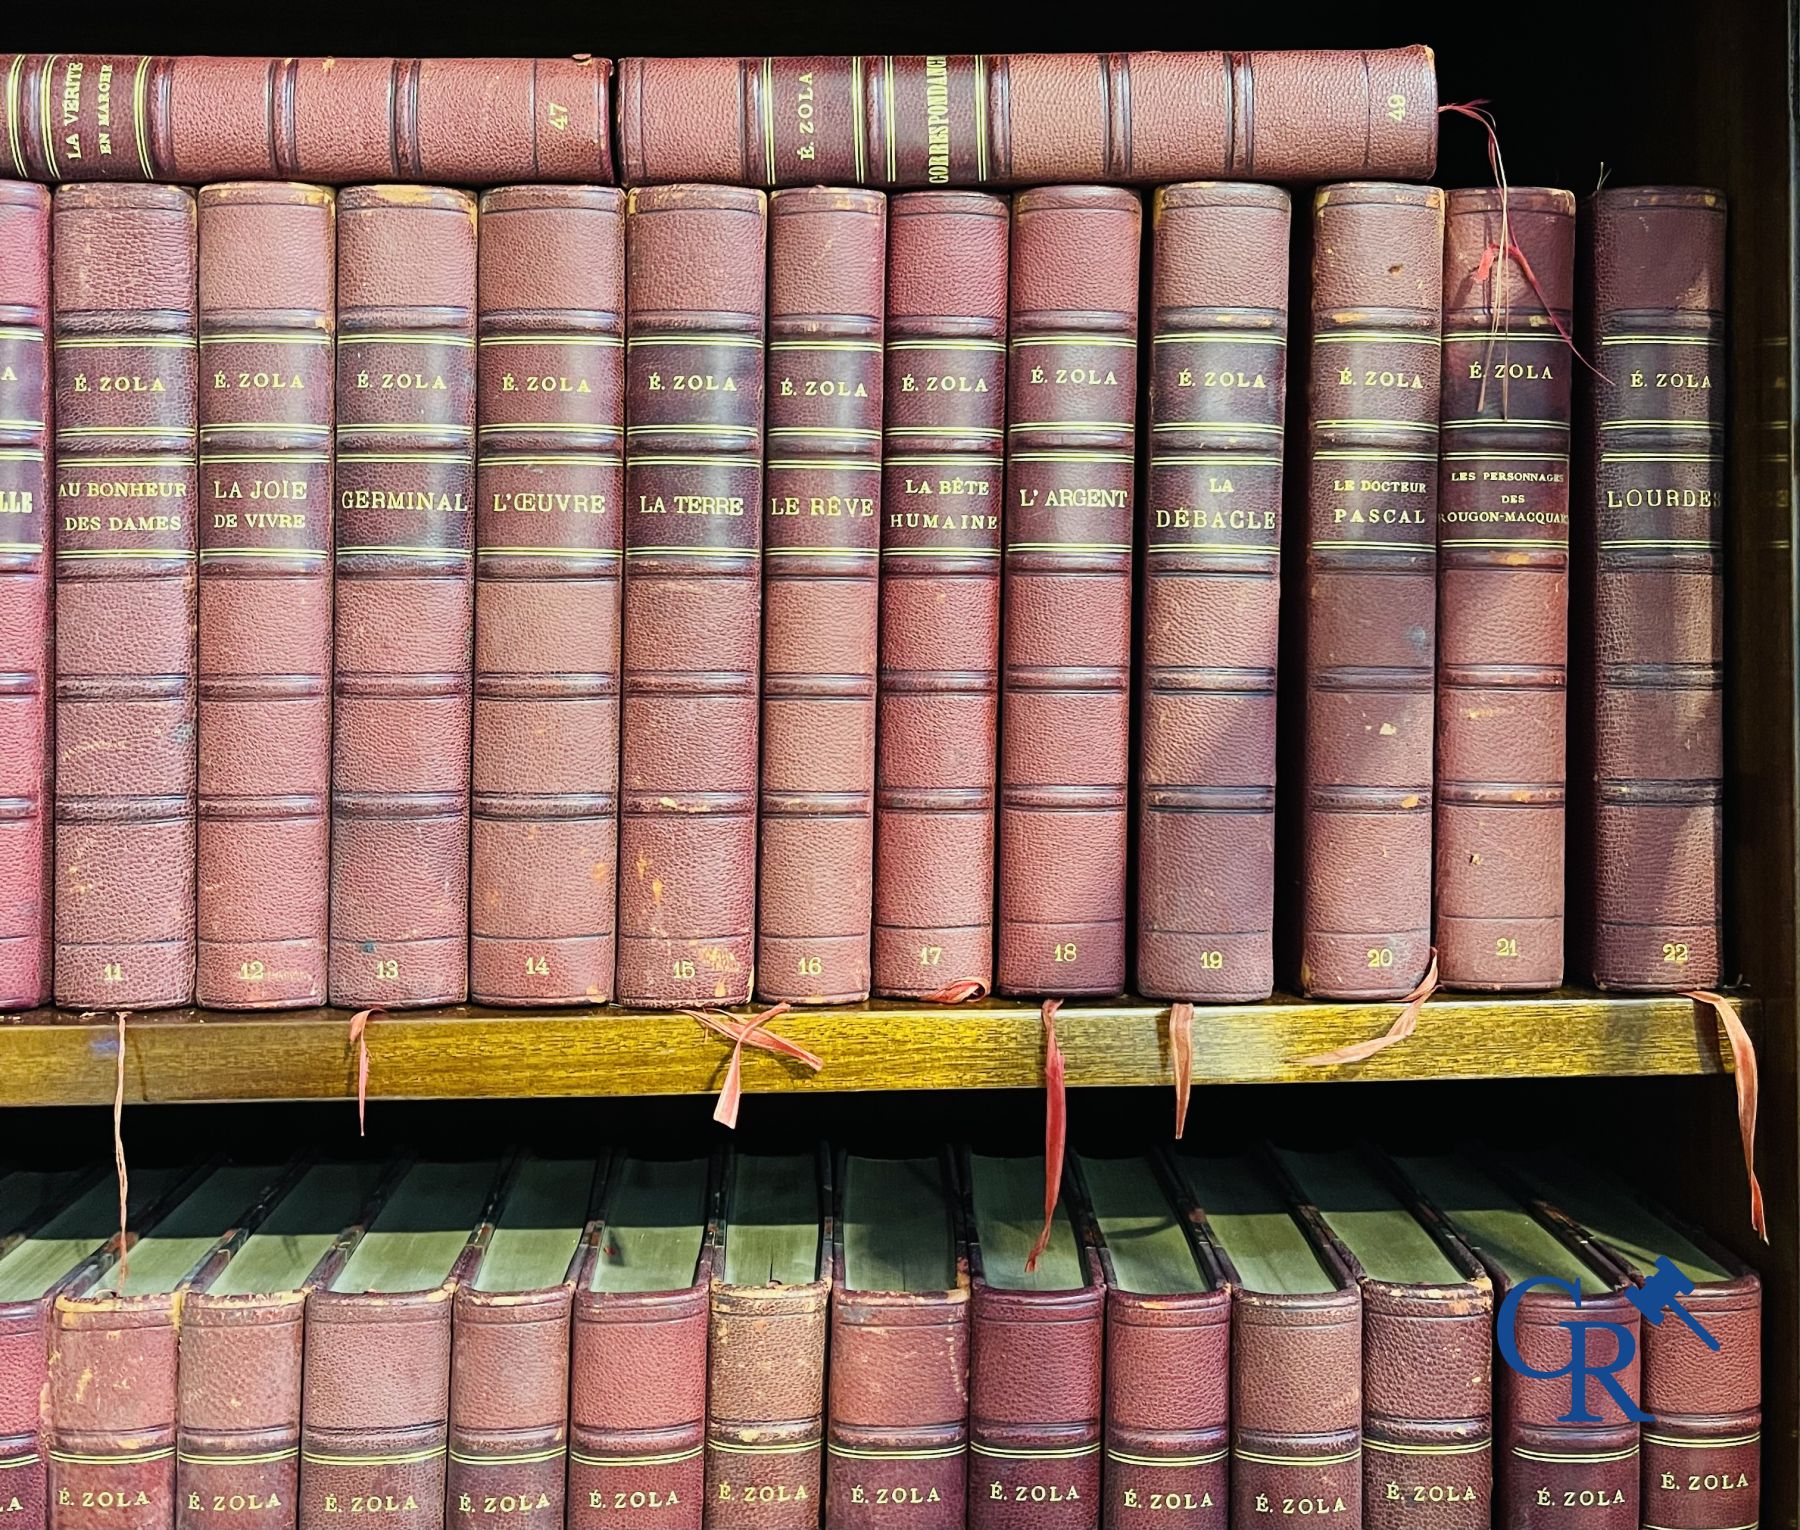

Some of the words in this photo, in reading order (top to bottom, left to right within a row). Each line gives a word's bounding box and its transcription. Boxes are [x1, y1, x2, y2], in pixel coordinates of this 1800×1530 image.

[62, 62, 83, 126] VÉRITÉ
[798, 73, 814, 134] ZOLA
[546, 99, 568, 131] 47
[66, 133, 82, 159] LA
[98, 133, 112, 155] EN
[797, 141, 815, 160] É.
[214, 370, 231, 389] É.
[240, 374, 304, 390] ZOLA
[357, 370, 373, 389] É.
[382, 373, 447, 391] ZOLA
[1031, 366, 1048, 384] É.
[1057, 369, 1118, 385] ZOLA
[1178, 368, 1196, 387] É.
[1204, 371, 1267, 388] ZOLA
[1338, 367, 1357, 386] É.
[1365, 371, 1423, 389] ZOLA
[1469, 361, 1486, 379] É.
[1495, 364, 1553, 380] ZOLA
[1630, 370, 1648, 388] É.
[1656, 373, 1712, 389] ZOLA
[74, 373, 92, 392] É.
[100, 376, 166, 393] ZOLA
[502, 372, 519, 392] É.
[527, 376, 592, 395] ZOLA
[648, 372, 666, 391] É.
[673, 375, 737, 391] ZOLA
[780, 377, 797, 397] É.
[805, 381, 868, 397] ZOLA
[901, 373, 919, 392] É.
[926, 376, 989, 392] ZOLA
[905, 479, 933, 495] LA
[939, 476, 989, 496] BÊTE
[1209, 478, 1234, 494] LA
[1333, 479, 1355, 492] LE
[1360, 480, 1426, 493] DOCTEUR
[1451, 472, 1476, 481] LES
[1483, 471, 1564, 483] PERSONNAGES
[59, 482, 81, 497] AU
[86, 482, 187, 498] BONHEUR
[214, 480, 242, 499] LA
[248, 480, 307, 499] JOIE
[1045, 489, 1129, 508] ARGENT
[1501, 494, 1525, 504] DES
[1607, 489, 1720, 509] LOURDES
[342, 490, 468, 512] GERMINAL
[639, 495, 666, 513] LA
[673, 495, 744, 516] TERRE
[771, 497, 801, 516] LE
[810, 495, 874, 518] RÊVE
[65, 516, 102, 532] DES
[109, 515, 182, 531] DAMES
[213, 514, 238, 529] DE
[245, 513, 306, 529] VIVRE
[889, 513, 998, 530] HUMAINE
[1334, 508, 1425, 524] PASCAL
[919, 946, 942, 965] 17
[1053, 943, 1078, 962] 18
[1495, 937, 1519, 957] 21
[1662, 943, 1688, 962] 22
[525, 956, 551, 976] 14
[798, 956, 822, 976] 16
[1199, 950, 1224, 970] 19
[1366, 949, 1393, 968] 20
[103, 964, 123, 982] 11
[239, 960, 265, 980] 12
[375, 960, 399, 979] 13
[672, 960, 696, 979] 15
[718, 1482, 735, 1502] É.
[742, 1484, 809, 1502] ZOLA
[989, 1481, 1008, 1501] É.
[1015, 1485, 1080, 1501] ZOLA
[1385, 1481, 1405, 1501] É.
[1413, 1485, 1477, 1502] ZOLA
[1661, 1472, 1681, 1490] É.
[1688, 1473, 1749, 1492] ZOLA
[59, 1487, 75, 1507] É.
[82, 1490, 150, 1508] ZOLA
[188, 1492, 205, 1511] É.
[212, 1492, 282, 1511] ZOLA
[324, 1492, 342, 1513] É.
[351, 1495, 419, 1513] ZOLA
[459, 1493, 476, 1513] É.
[484, 1493, 551, 1513] ZOLA
[589, 1490, 606, 1509] É.
[614, 1490, 680, 1509] ZOLA
[851, 1484, 869, 1504] É.
[878, 1486, 940, 1504] ZOLA
[1124, 1489, 1142, 1508] É.
[1150, 1491, 1214, 1509] ZOLA
[1255, 1493, 1274, 1513] É.
[1283, 1496, 1347, 1515] ZOLA
[1537, 1488, 1556, 1506] É.
[1563, 1489, 1626, 1506] ZOLA
